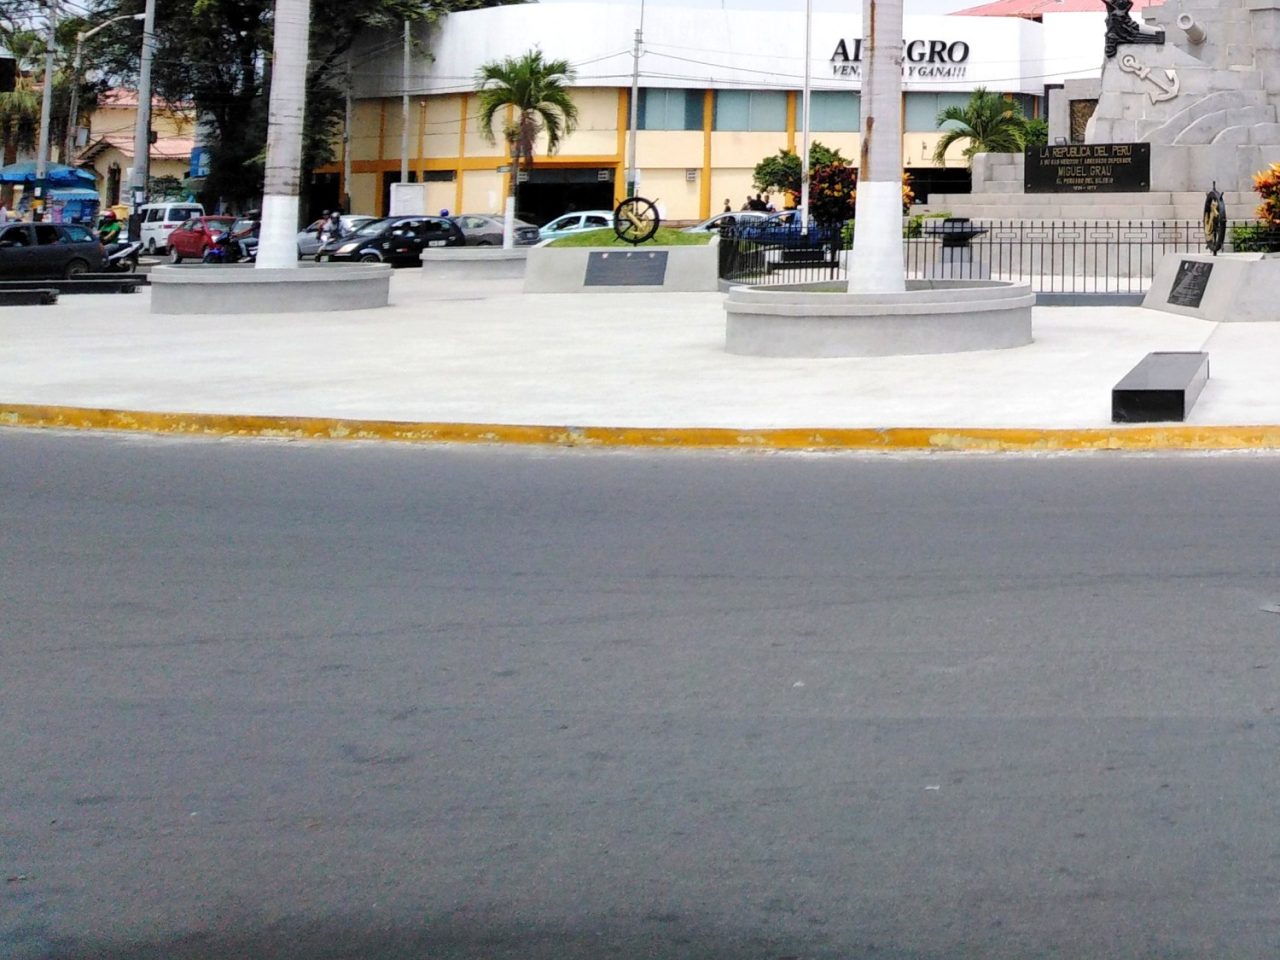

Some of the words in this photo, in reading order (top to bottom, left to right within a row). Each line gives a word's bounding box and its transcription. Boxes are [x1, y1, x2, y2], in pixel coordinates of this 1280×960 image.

[830, 38, 970, 63] ALGRO
[908, 66, 917, 77] Y
[918, 66, 967, 78] GANA!!!
[1039, 147, 1050, 158] LA
[1052, 146, 1091, 158] REPUBLICA
[1094, 146, 1108, 157] DEL
[1057, 166, 1087, 177] MIGUEL
[1090, 165, 1112, 176] GRAU
